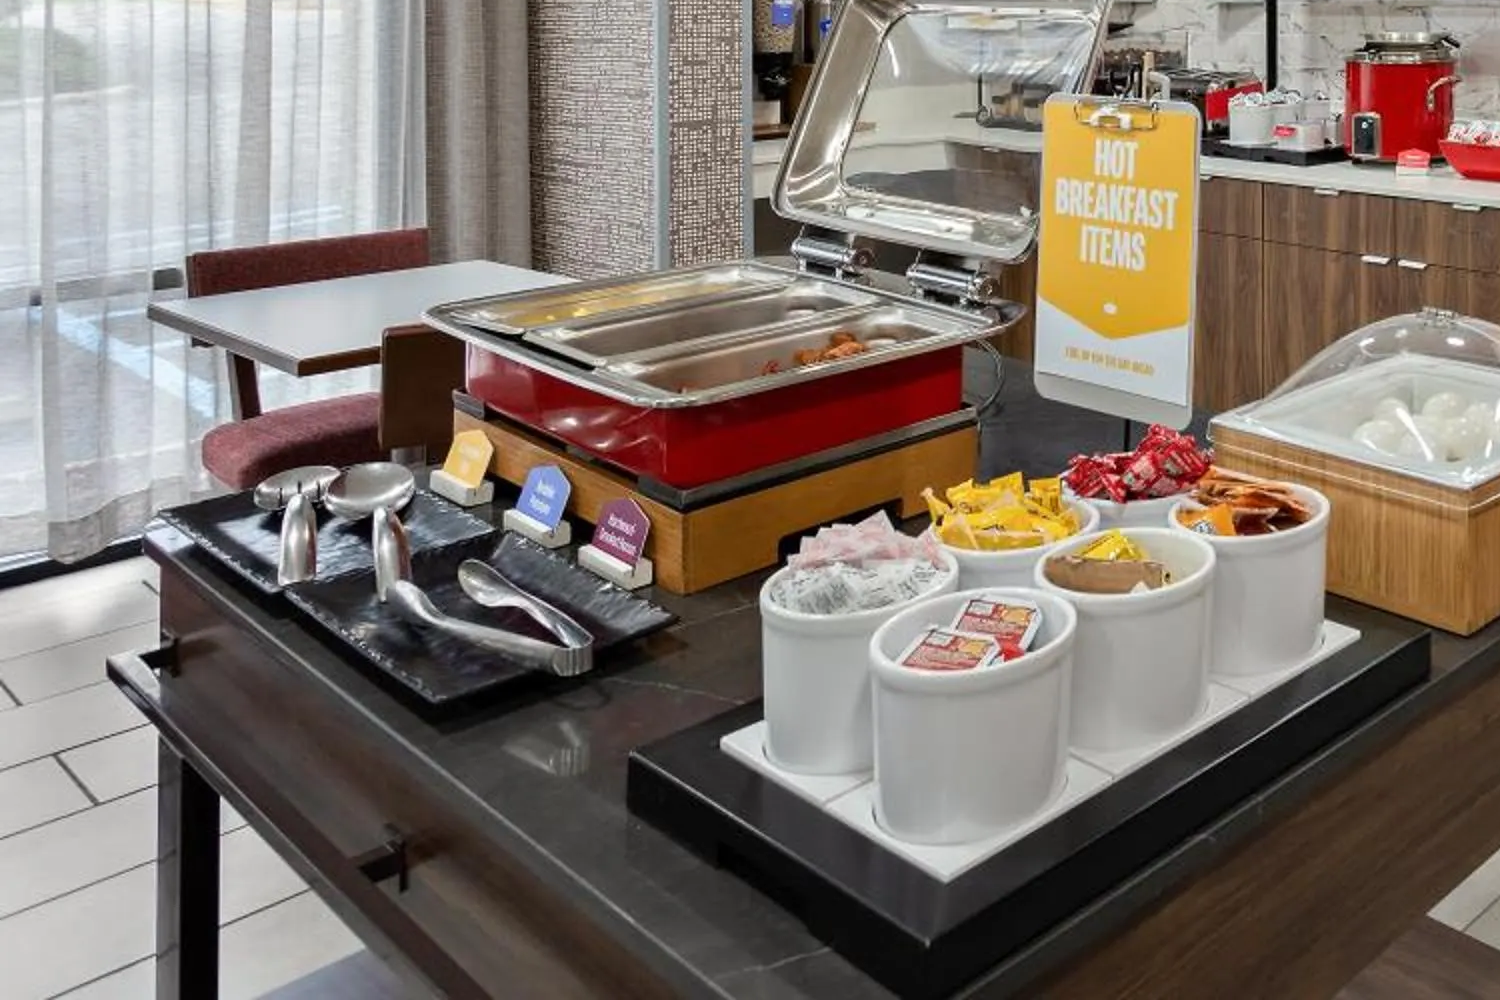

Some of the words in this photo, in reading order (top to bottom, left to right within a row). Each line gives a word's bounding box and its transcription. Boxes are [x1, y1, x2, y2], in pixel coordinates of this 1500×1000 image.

[1094, 138, 1139, 178] HOT
[1055, 176, 1179, 231] BREAKFAST
[1079, 223, 1146, 271] ITEMS
